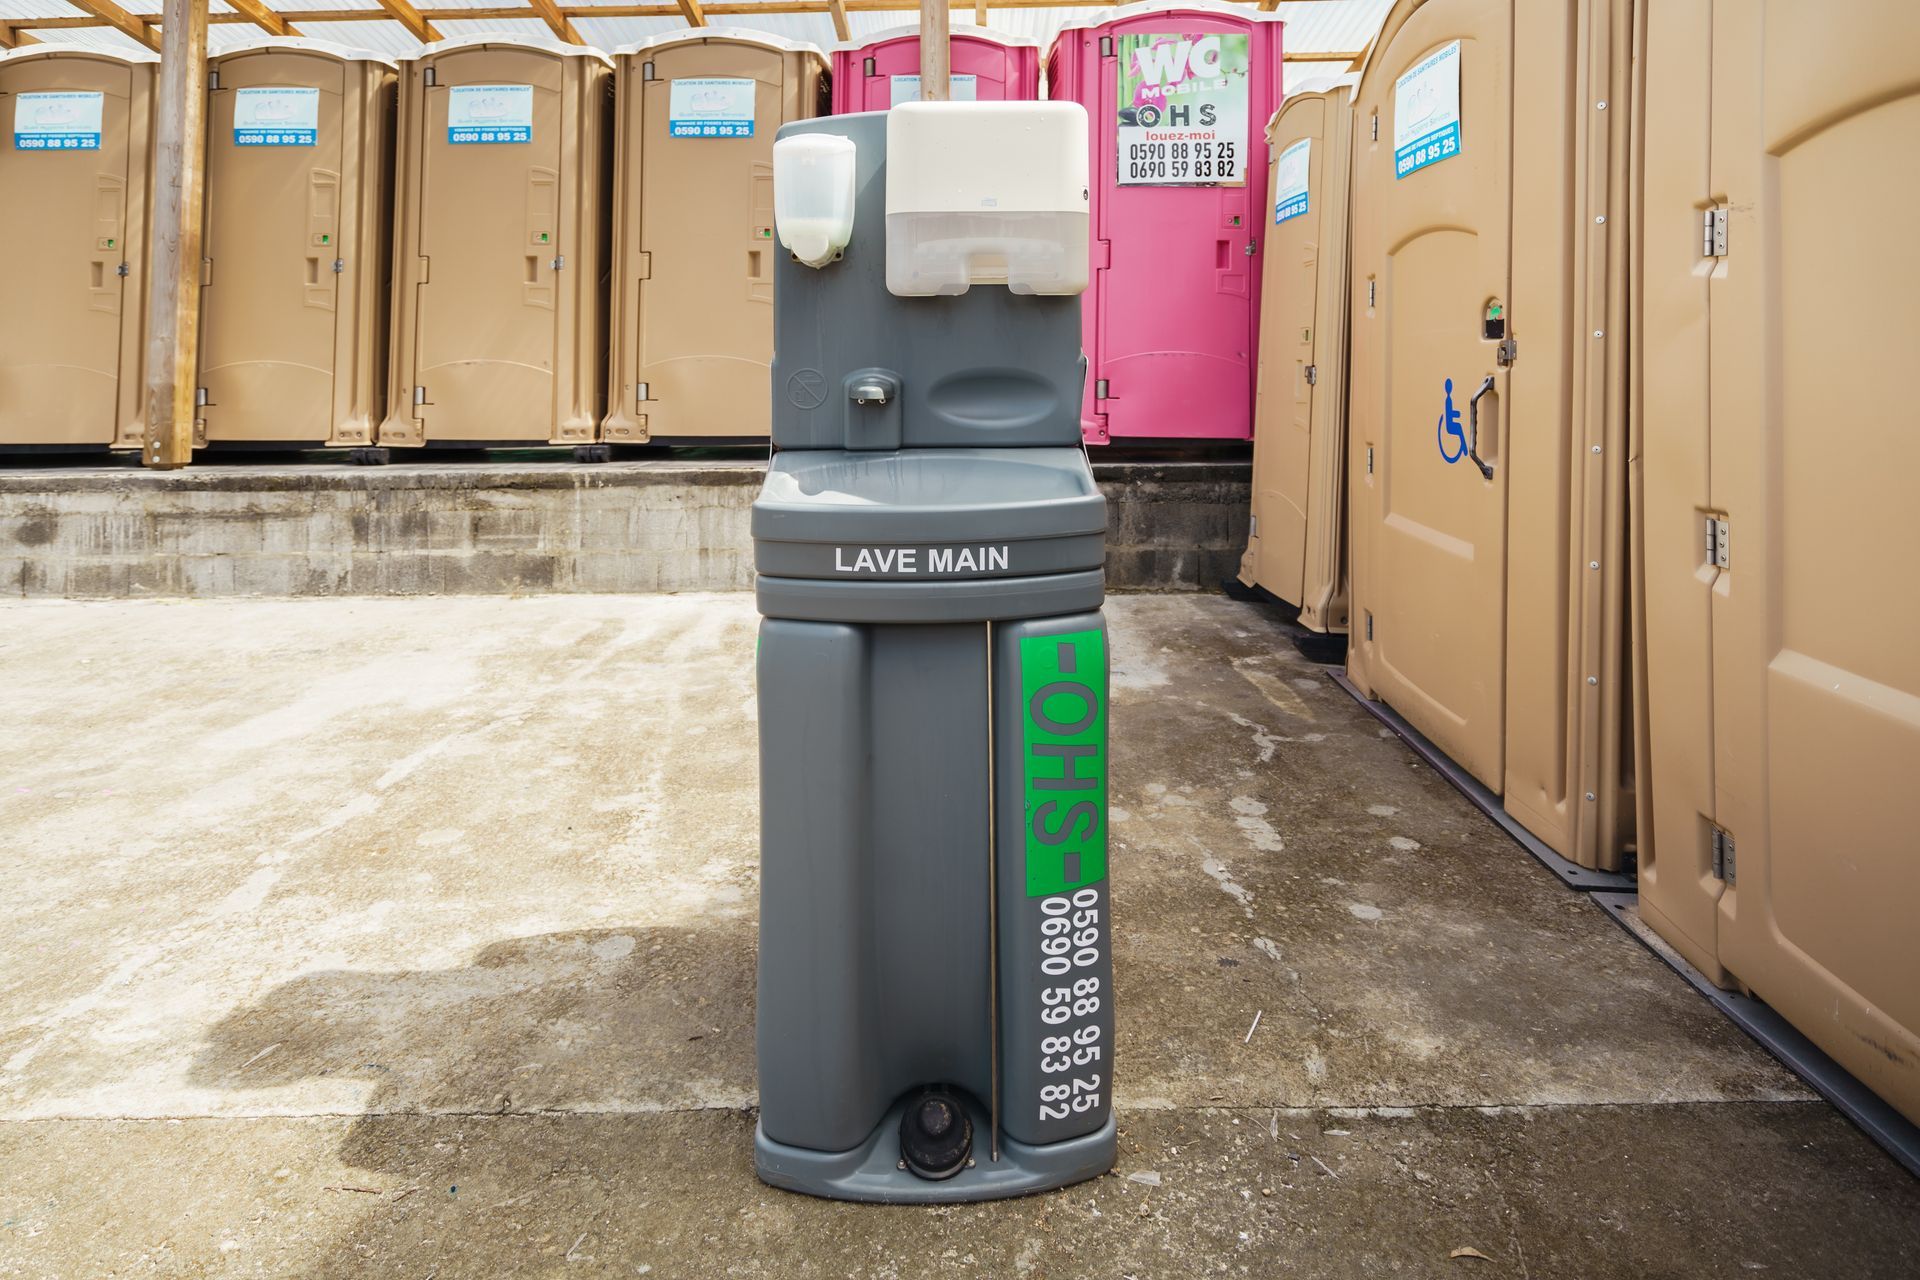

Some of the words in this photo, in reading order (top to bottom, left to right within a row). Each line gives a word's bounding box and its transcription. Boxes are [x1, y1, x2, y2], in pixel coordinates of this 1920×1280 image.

[1135, 36, 1220, 86] WC
[1141, 79, 1228, 99] MOBILE
[20, 140, 46, 148] 0590
[48, 139, 62, 147] 88
[64, 139, 78, 147] 95
[81, 139, 96, 147] 25
[239, 135, 264, 143] 0590
[266, 135, 280, 143] 88
[282, 135, 296, 143] 95
[298, 135, 312, 143] 25
[453, 133, 479, 141] 0590
[481, 133, 495, 141] 88
[497, 132, 511, 140] 95
[513, 132, 528, 140] 25
[674, 126, 700, 135] 0590
[703, 126, 718, 135] 88
[720, 126, 734, 135] 95
[736, 126, 750, 135] 25
[1146, 130, 1216, 141] louez-moi
[1130, 143, 1166, 160] 0590
[1172, 143, 1188, 159] 88
[1194, 142, 1212, 159] 95
[1218, 142, 1234, 158] 25
[1130, 162, 1166, 178] 0690
[1172, 161, 1188, 178] 59
[1194, 160, 1212, 177] 83
[1218, 160, 1234, 177] 82
[1398, 158, 1414, 174] 0590
[1416, 149, 1426, 166] 88
[1428, 142, 1440, 160] 95
[1442, 136, 1456, 153] 25
[835, 548, 917, 572] LAVE
[928, 546, 1009, 572] MAIN
[1040, 896, 1072, 976] 0690
[1072, 888, 1099, 966] 0590
[1040, 987, 1072, 1024] 59
[1072, 976, 1100, 1016] 88
[1040, 1036, 1072, 1074] 83
[1072, 1025, 1100, 1066] 95
[1039, 1085, 1071, 1121] 82
[1072, 1074, 1100, 1112] 25
